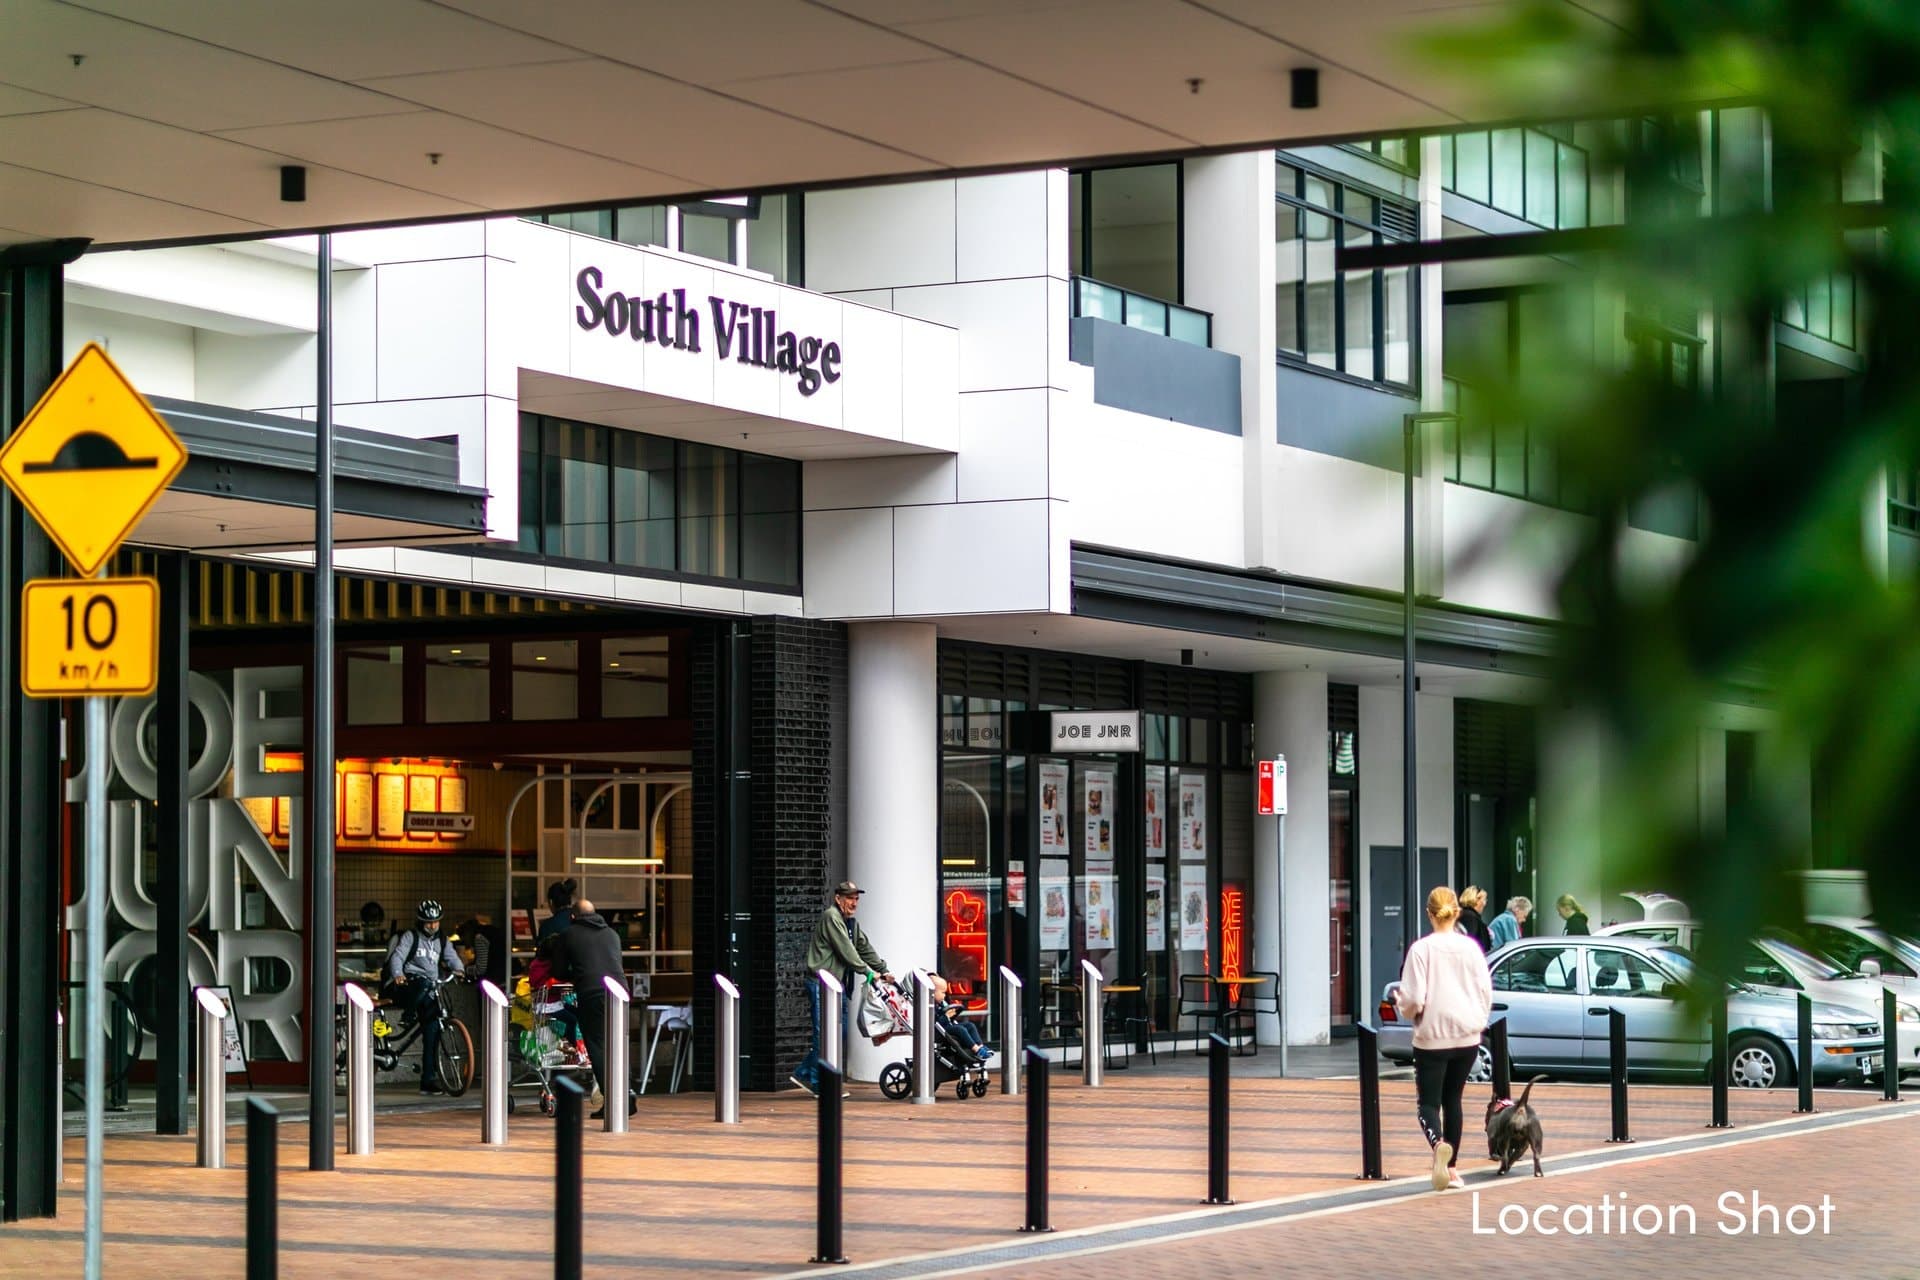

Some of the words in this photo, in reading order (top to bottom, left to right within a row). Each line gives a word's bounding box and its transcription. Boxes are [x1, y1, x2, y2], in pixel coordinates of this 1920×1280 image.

[576, 266, 701, 353] South
[708, 296, 842, 397] Village
[61, 594, 117, 651] 10
[59, 660, 119, 681] km/h
[66, 666, 304, 802] OE
[1057, 724, 1091, 738] JOE
[1097, 724, 1132, 738] JNR
[1516, 836, 1523, 872] 6
